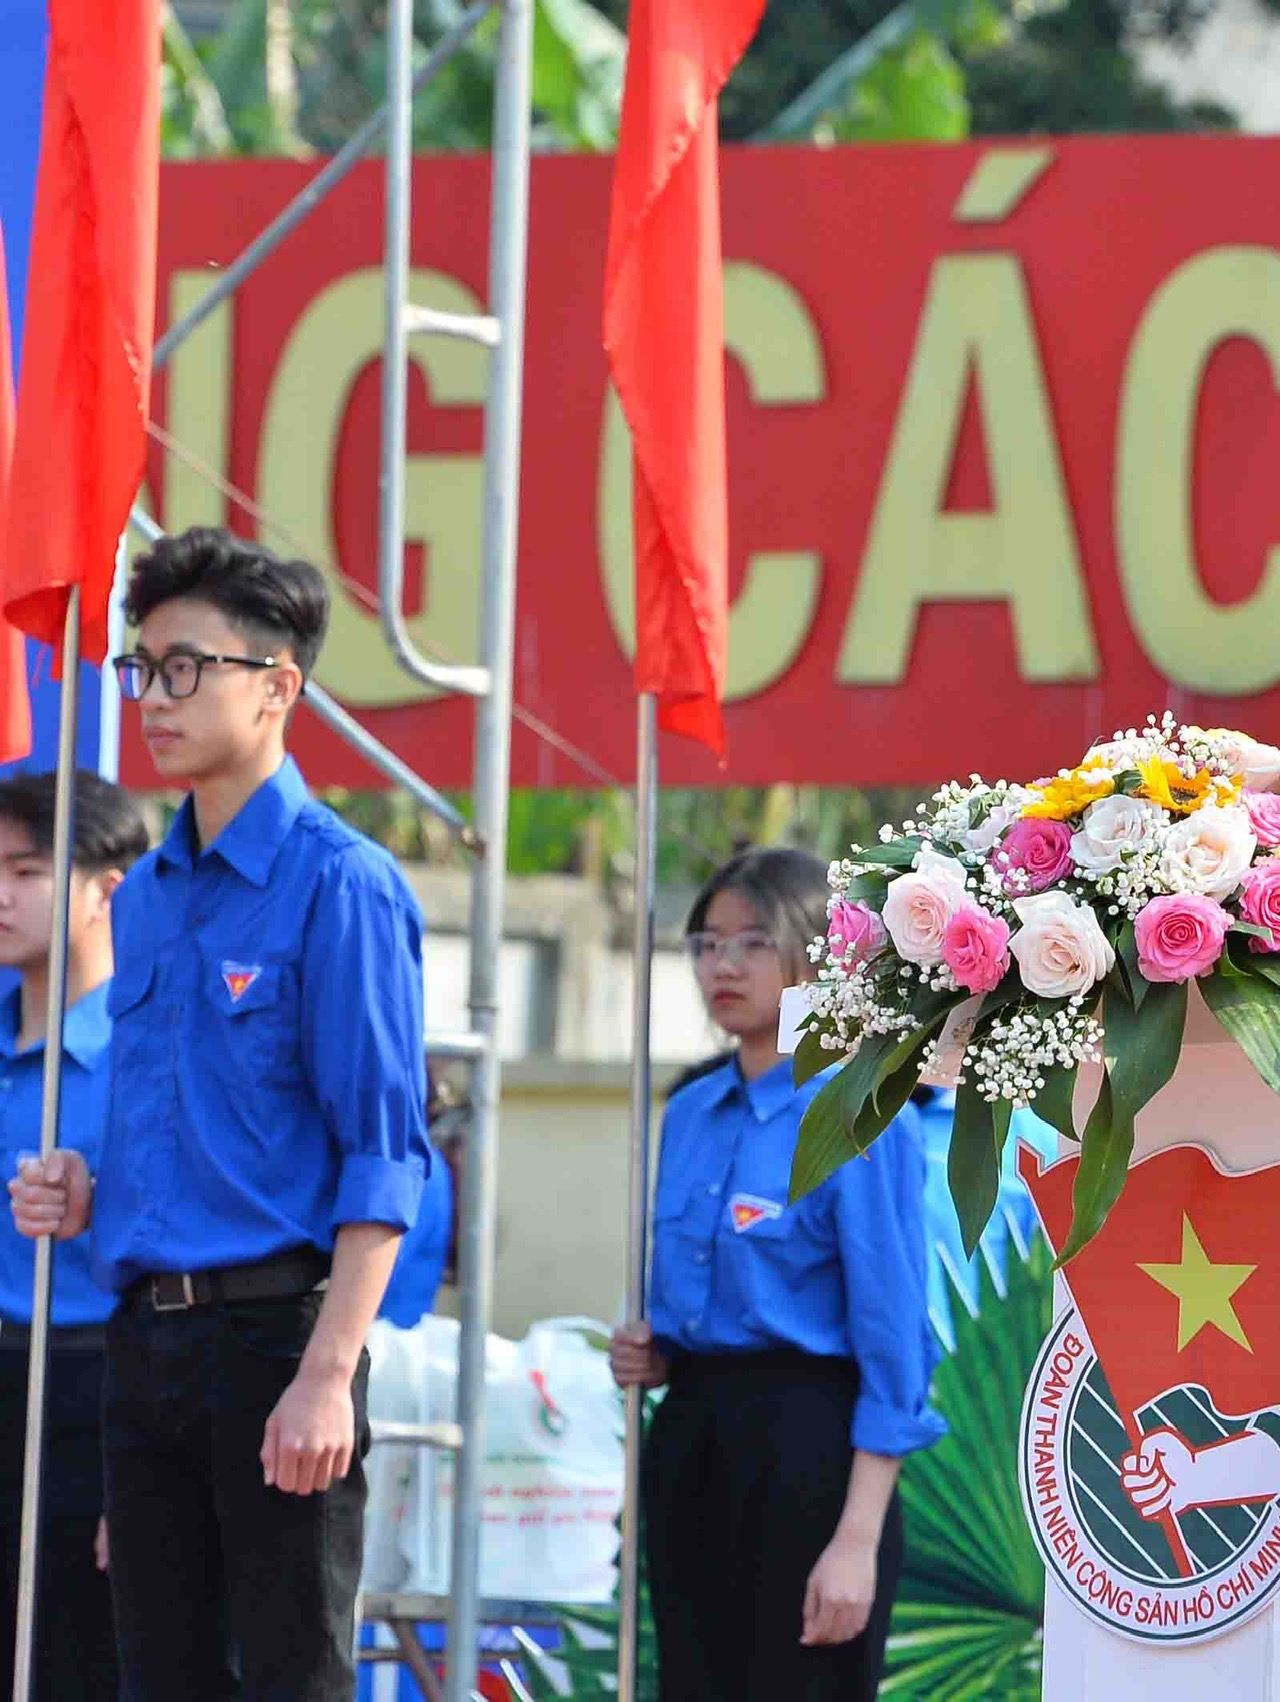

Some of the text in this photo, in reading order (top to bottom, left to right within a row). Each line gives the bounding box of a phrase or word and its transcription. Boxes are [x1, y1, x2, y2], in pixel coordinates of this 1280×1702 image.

[127, 265, 490, 708] G
[1040, 1333, 1084, 1409] ĐOÀN
[1034, 1413, 1059, 1506] THANH
[1043, 1505, 1083, 1569] NIÊN
[1076, 1561, 1133, 1616] CỘNG
[1135, 1592, 1178, 1626] SẢN
[1183, 1586, 1214, 1624] HỒ
[1217, 1563, 1255, 1609] CHÍ
